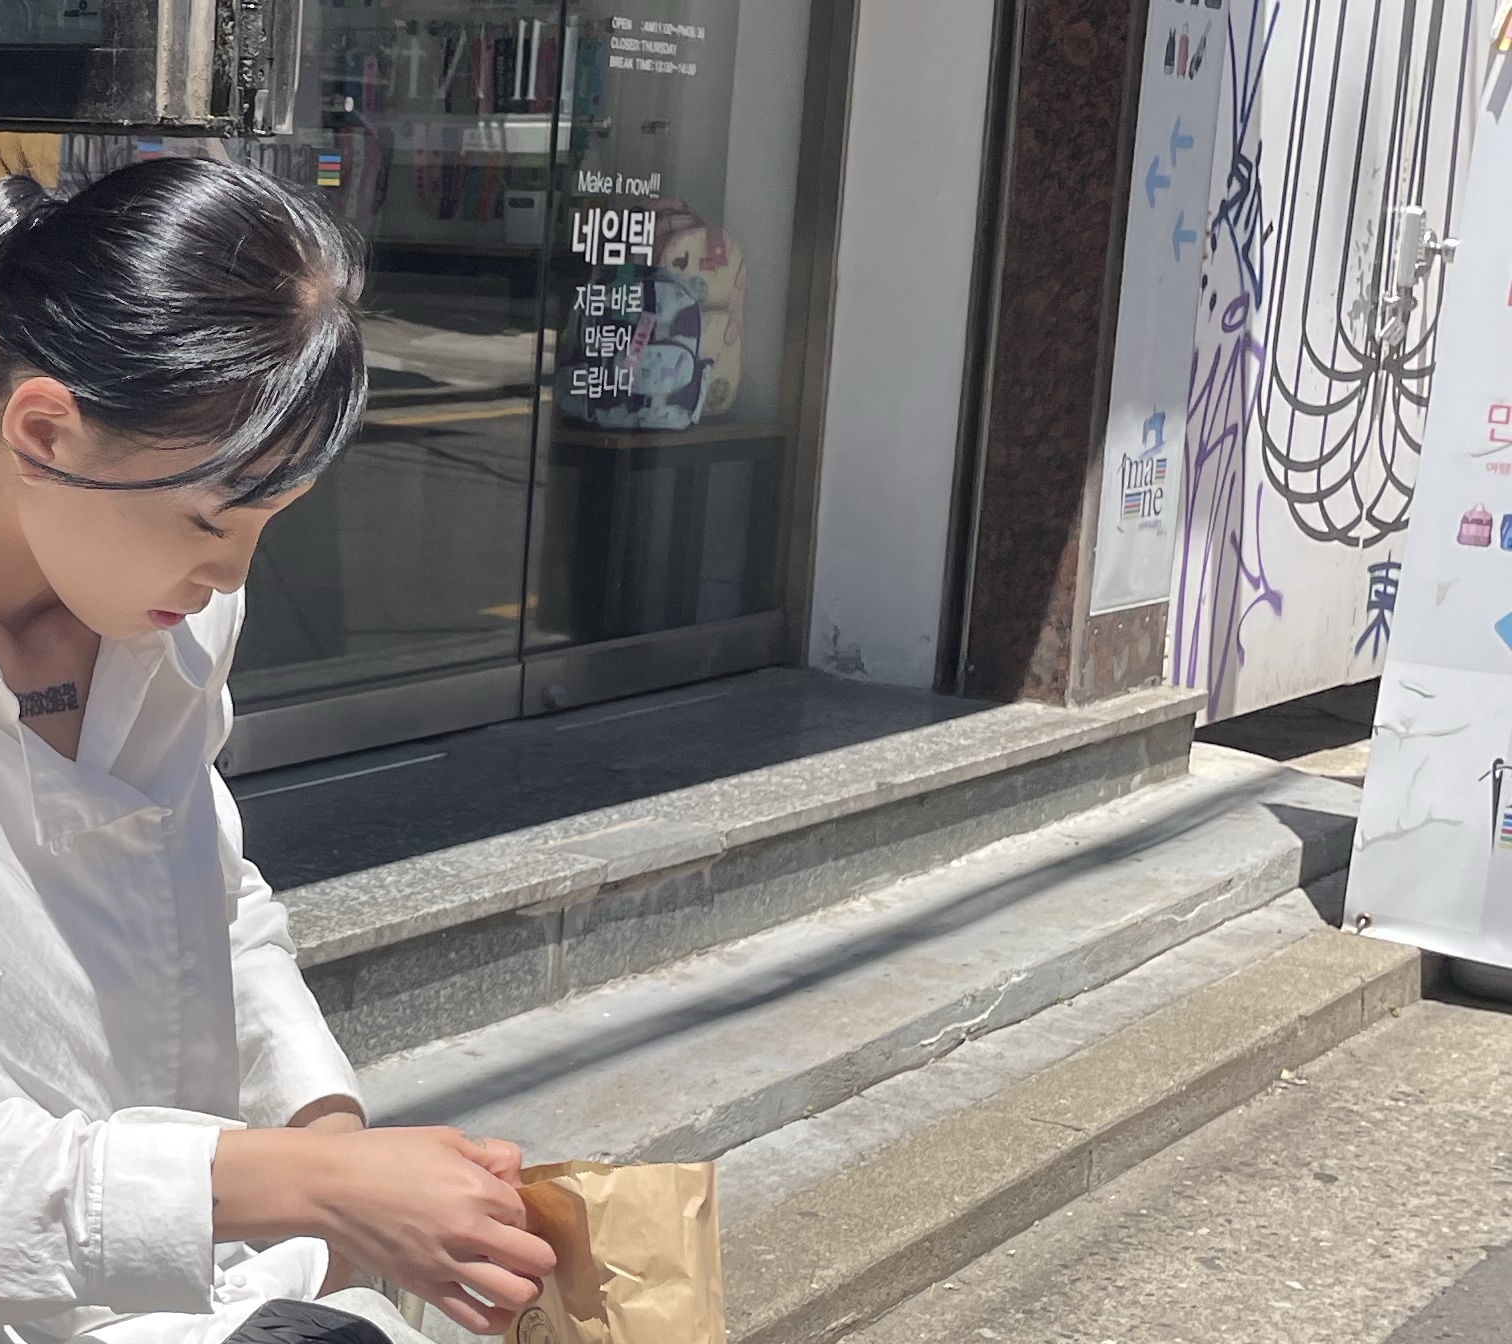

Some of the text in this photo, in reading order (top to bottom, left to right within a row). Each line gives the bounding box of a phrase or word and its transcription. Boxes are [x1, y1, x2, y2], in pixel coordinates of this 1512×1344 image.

[577, 169, 613, 195] Make
[571, 207, 656, 267] 네임택
[573, 283, 643, 316] 지금 바로
[585, 324, 632, 357] 만들어
[570, 365, 634, 398] 드립니다
